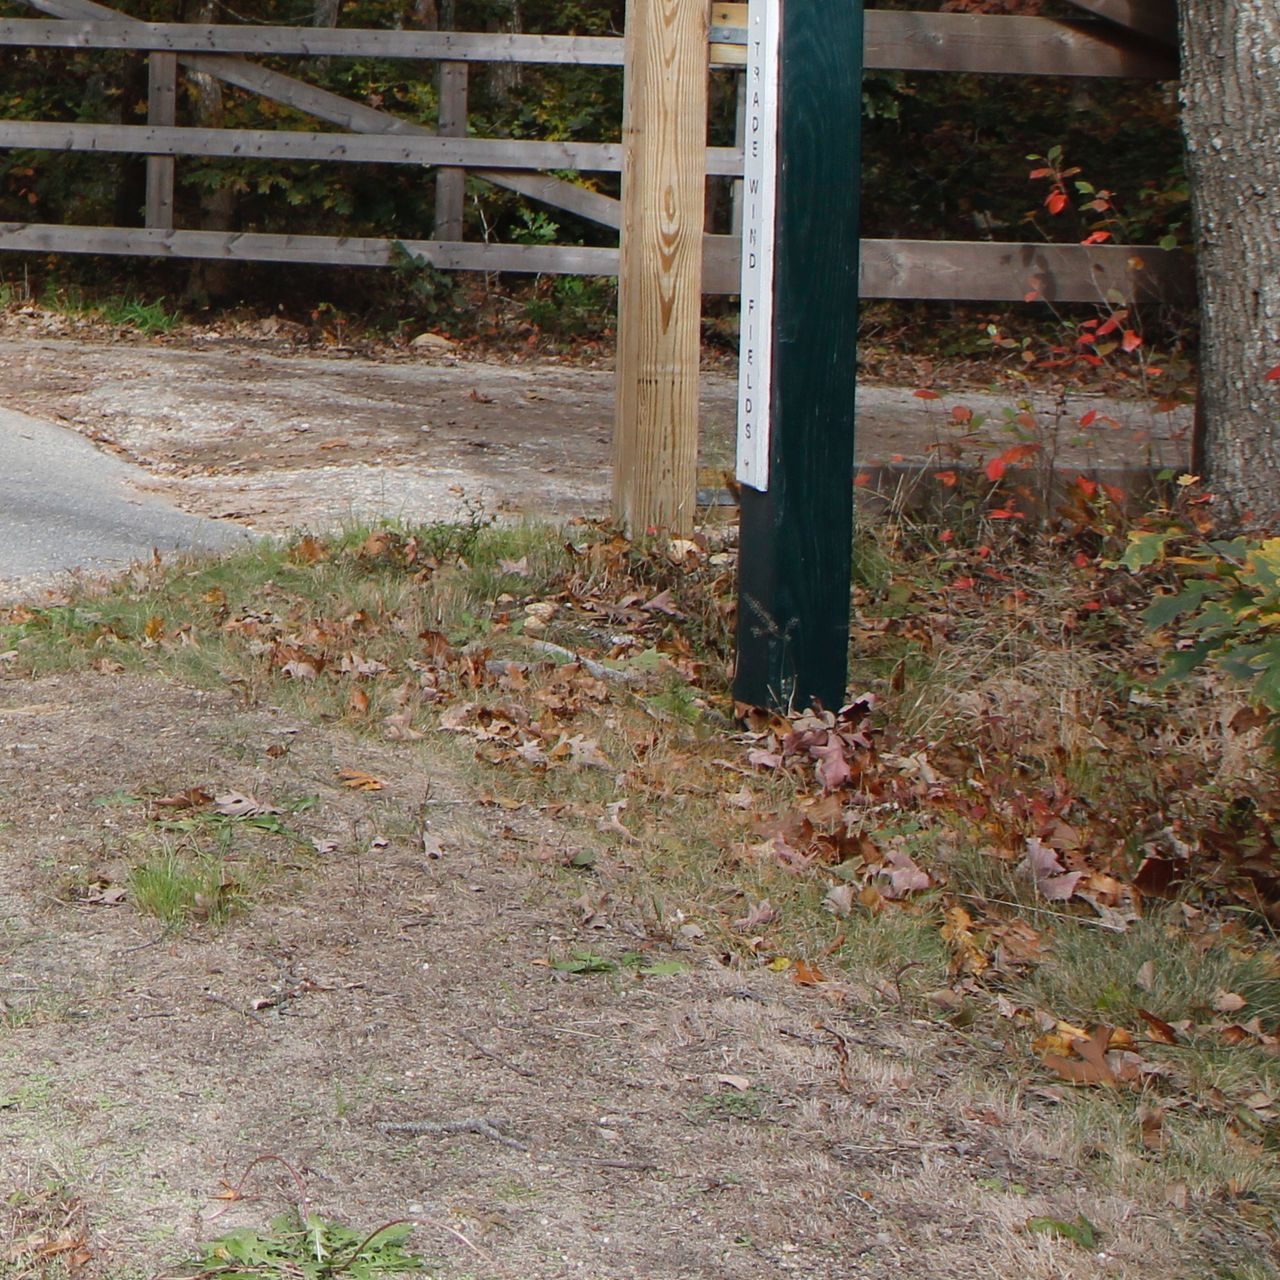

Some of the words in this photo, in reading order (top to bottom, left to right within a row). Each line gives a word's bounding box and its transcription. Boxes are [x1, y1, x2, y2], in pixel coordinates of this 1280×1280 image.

[752, 41, 760, 158] TRADE
[749, 178, 759, 269] WIND
[745, 299, 754, 439] FIELDS
